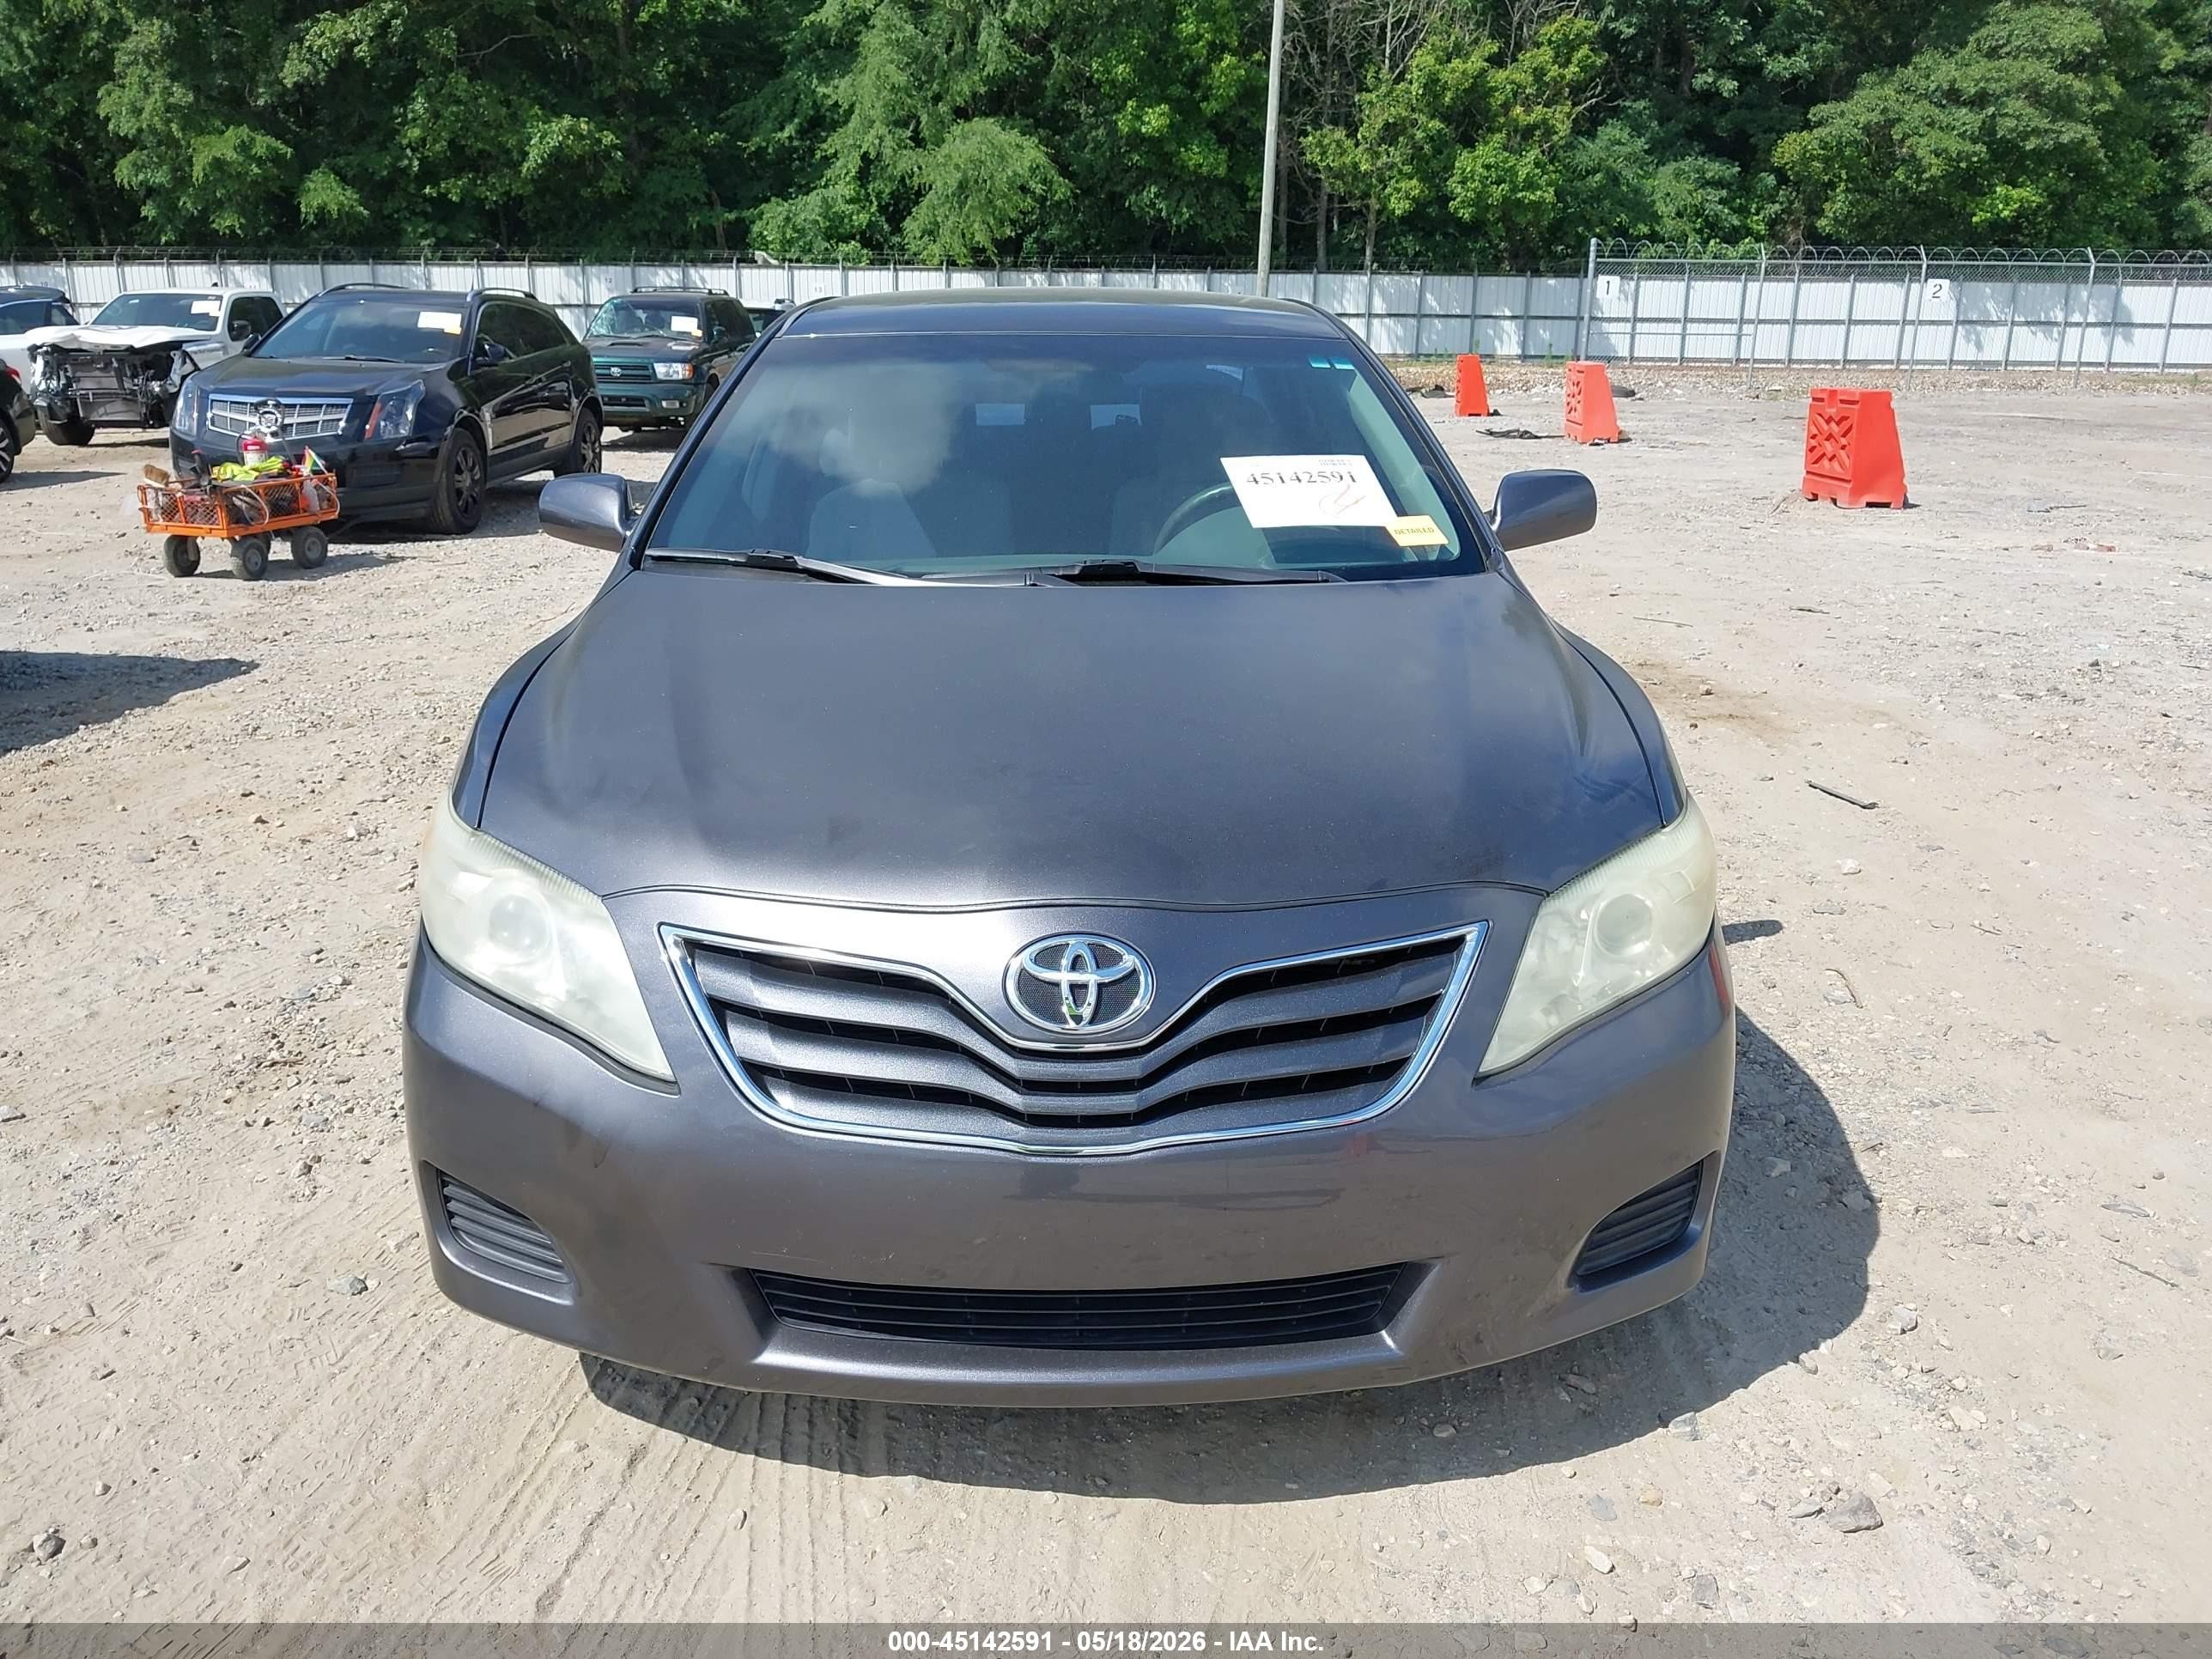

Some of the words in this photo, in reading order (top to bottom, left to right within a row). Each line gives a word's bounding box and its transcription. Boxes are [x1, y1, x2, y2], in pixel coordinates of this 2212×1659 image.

[1606, 280, 1611, 296] 1
[1931, 283, 1943, 299] 2
[1246, 471, 1357, 485] 45142591
[1394, 526, 1435, 535] DETAILED
